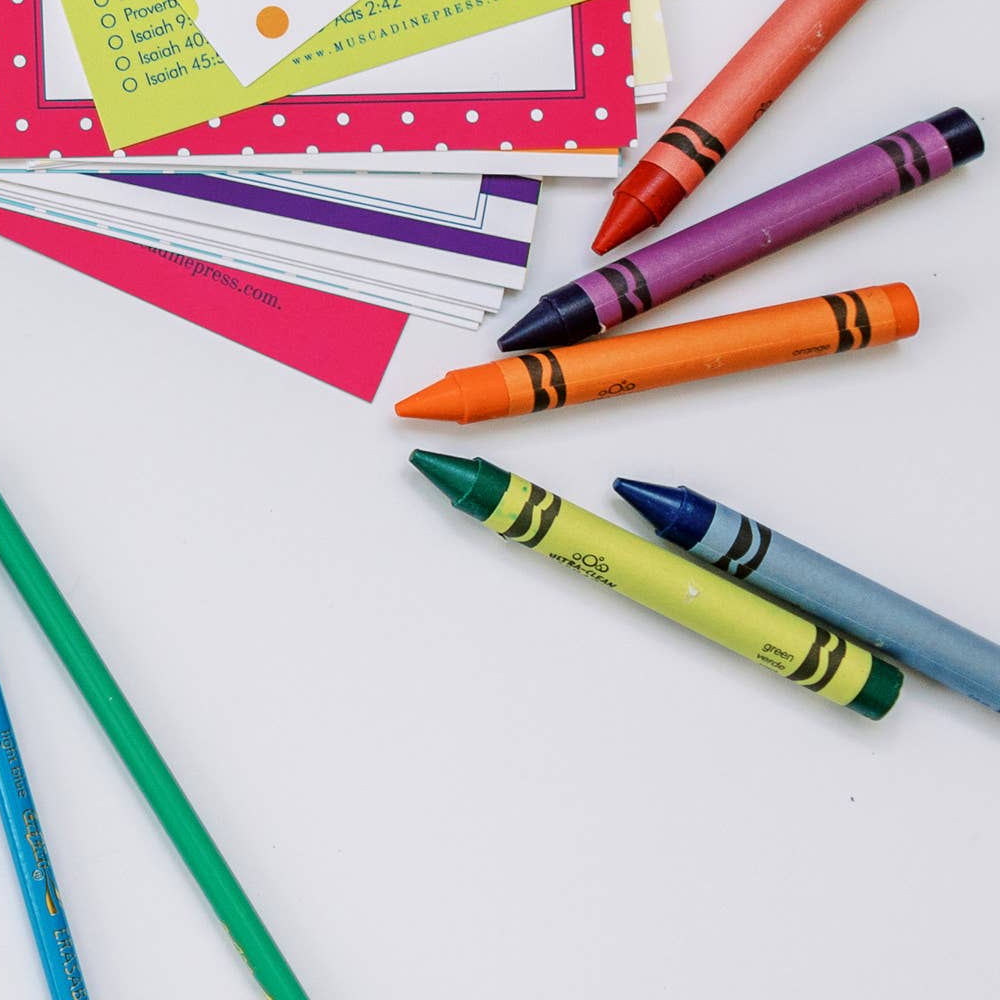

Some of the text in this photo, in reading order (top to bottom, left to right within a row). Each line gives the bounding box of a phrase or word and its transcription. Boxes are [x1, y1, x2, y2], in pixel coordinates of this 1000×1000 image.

[334, 7, 364, 27] Acts
[131, 18, 174, 44] Isaiah
[138, 40, 181, 65] Isaiah
[145, 61, 189, 87] Isaiah
[762, 643, 794, 662] green
[11, 766, 28, 799] blue
